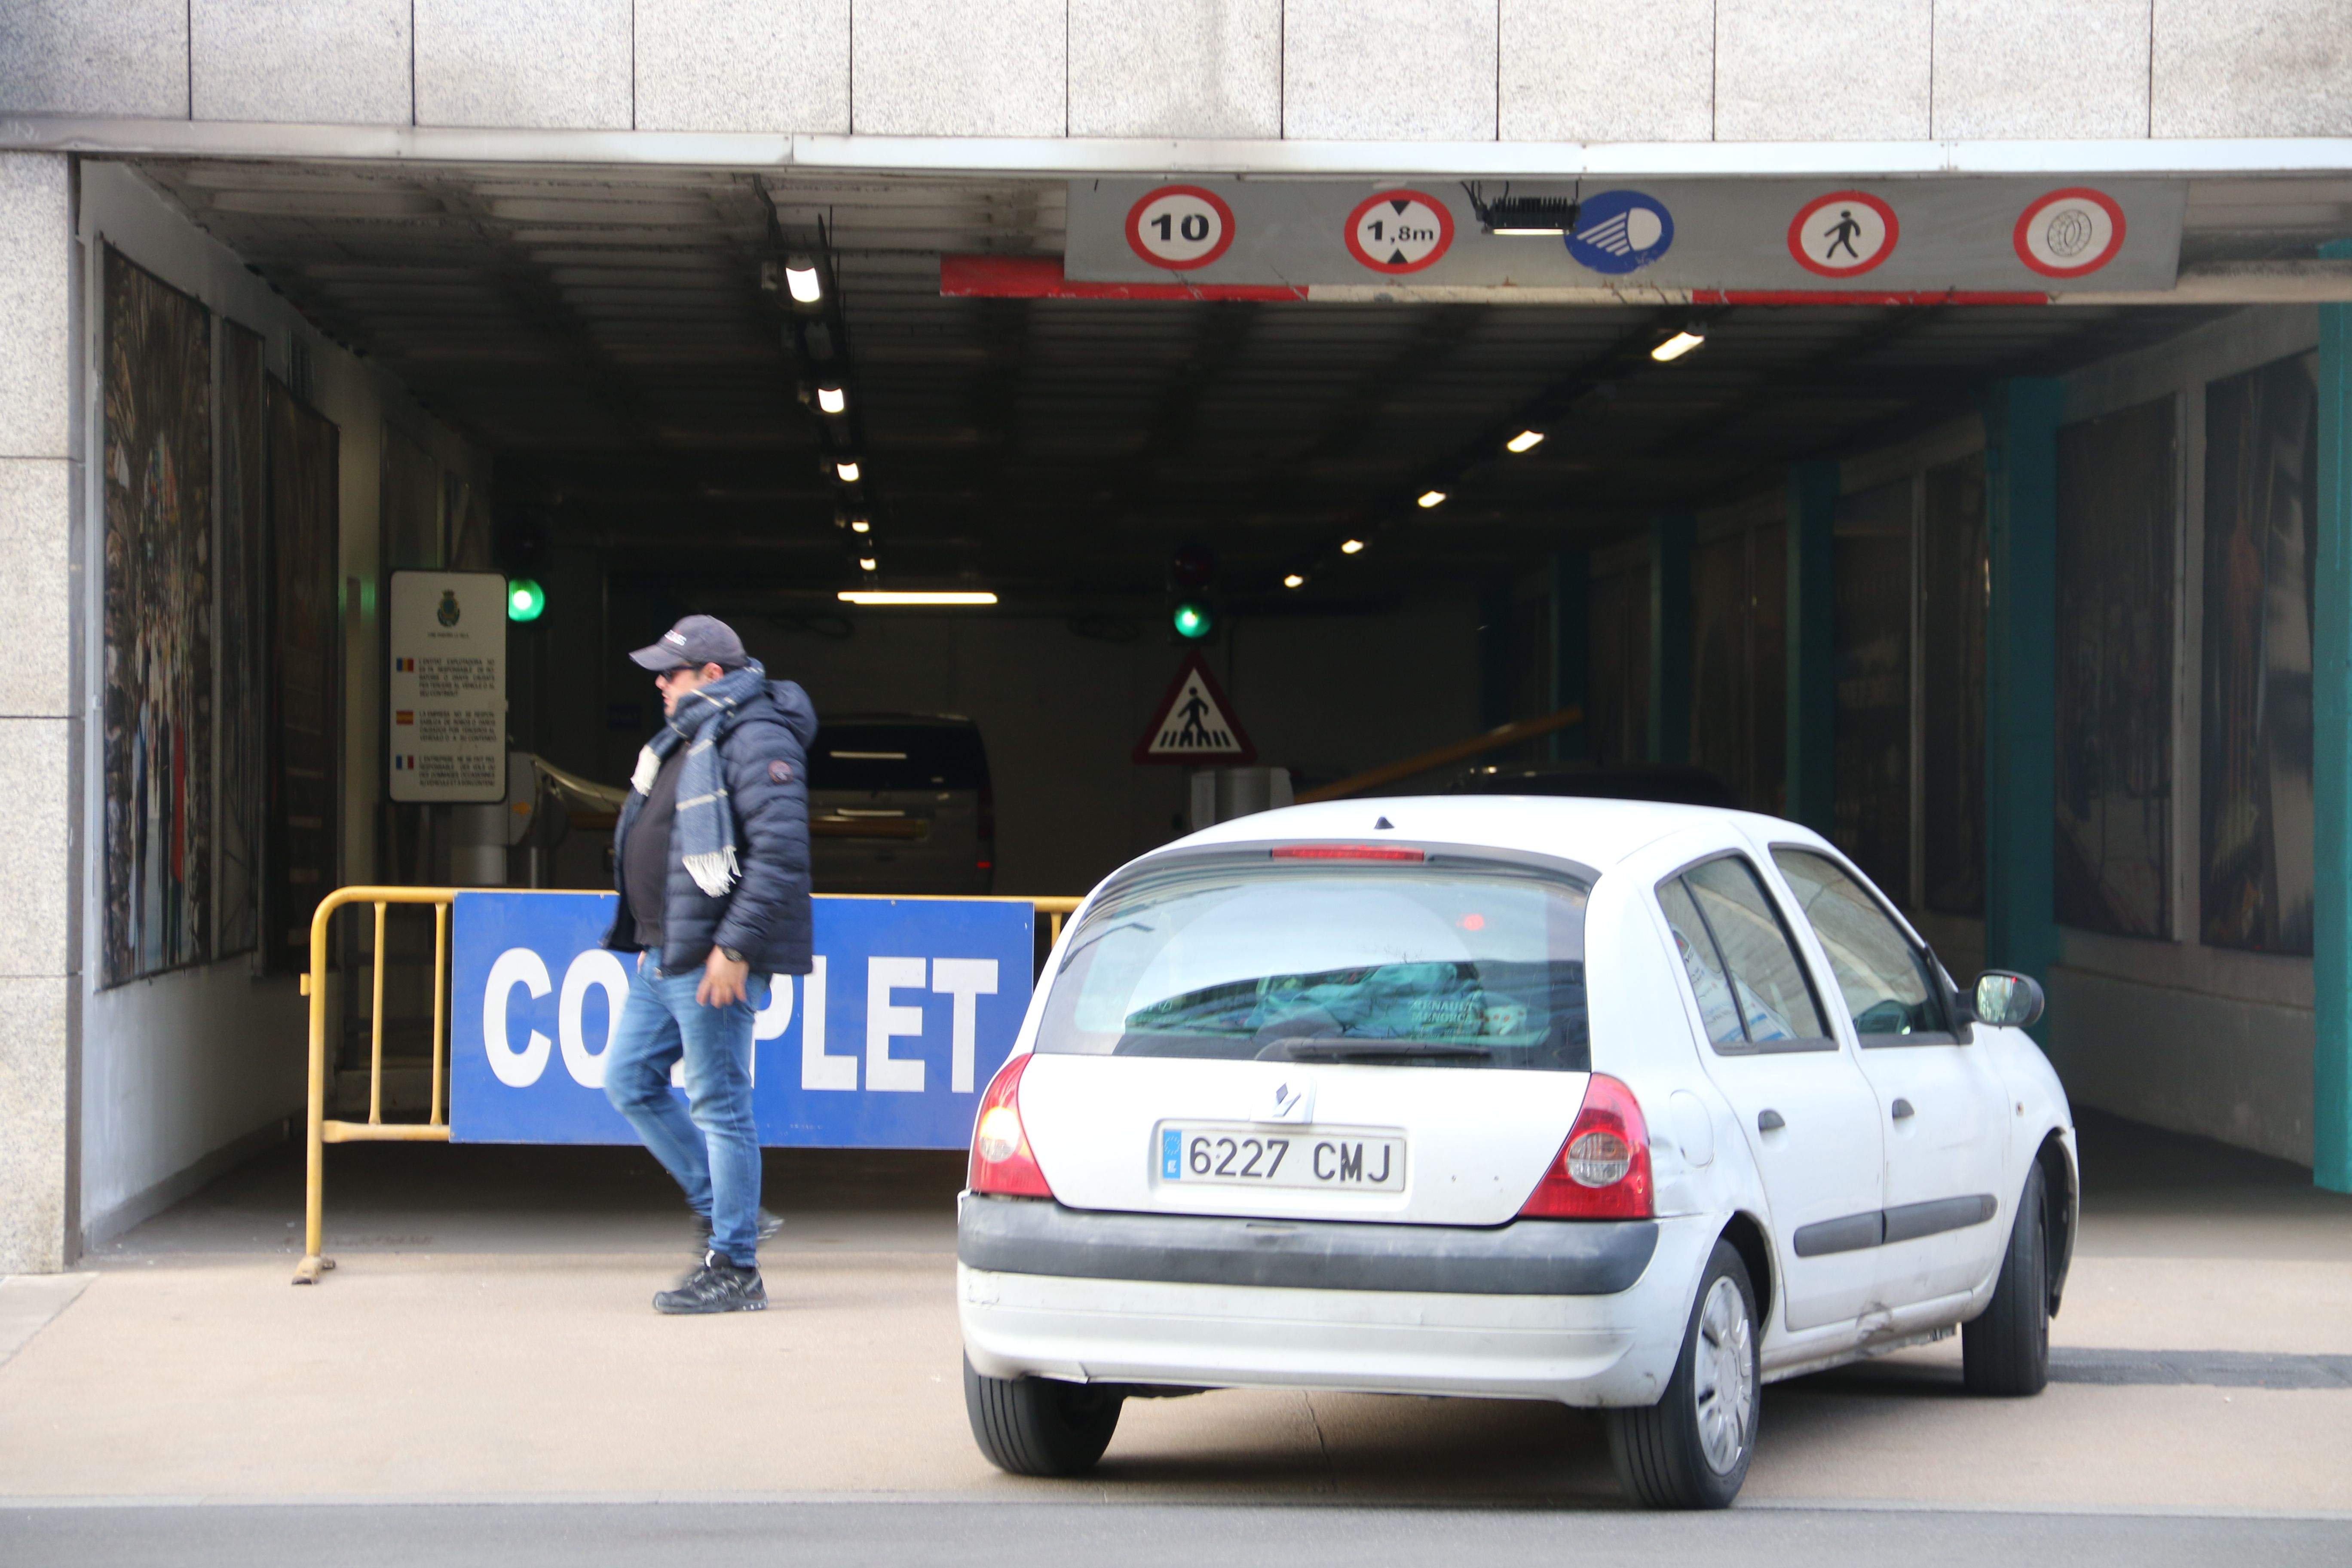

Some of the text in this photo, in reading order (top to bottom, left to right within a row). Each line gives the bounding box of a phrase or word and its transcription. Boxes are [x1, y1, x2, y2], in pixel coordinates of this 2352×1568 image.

[1151, 214, 1209, 241] 10
[1367, 221, 1434, 242] 1,8m
[483, 947, 998, 1093] COPLET
[1190, 1138, 1390, 1182] 6227 CMJ
